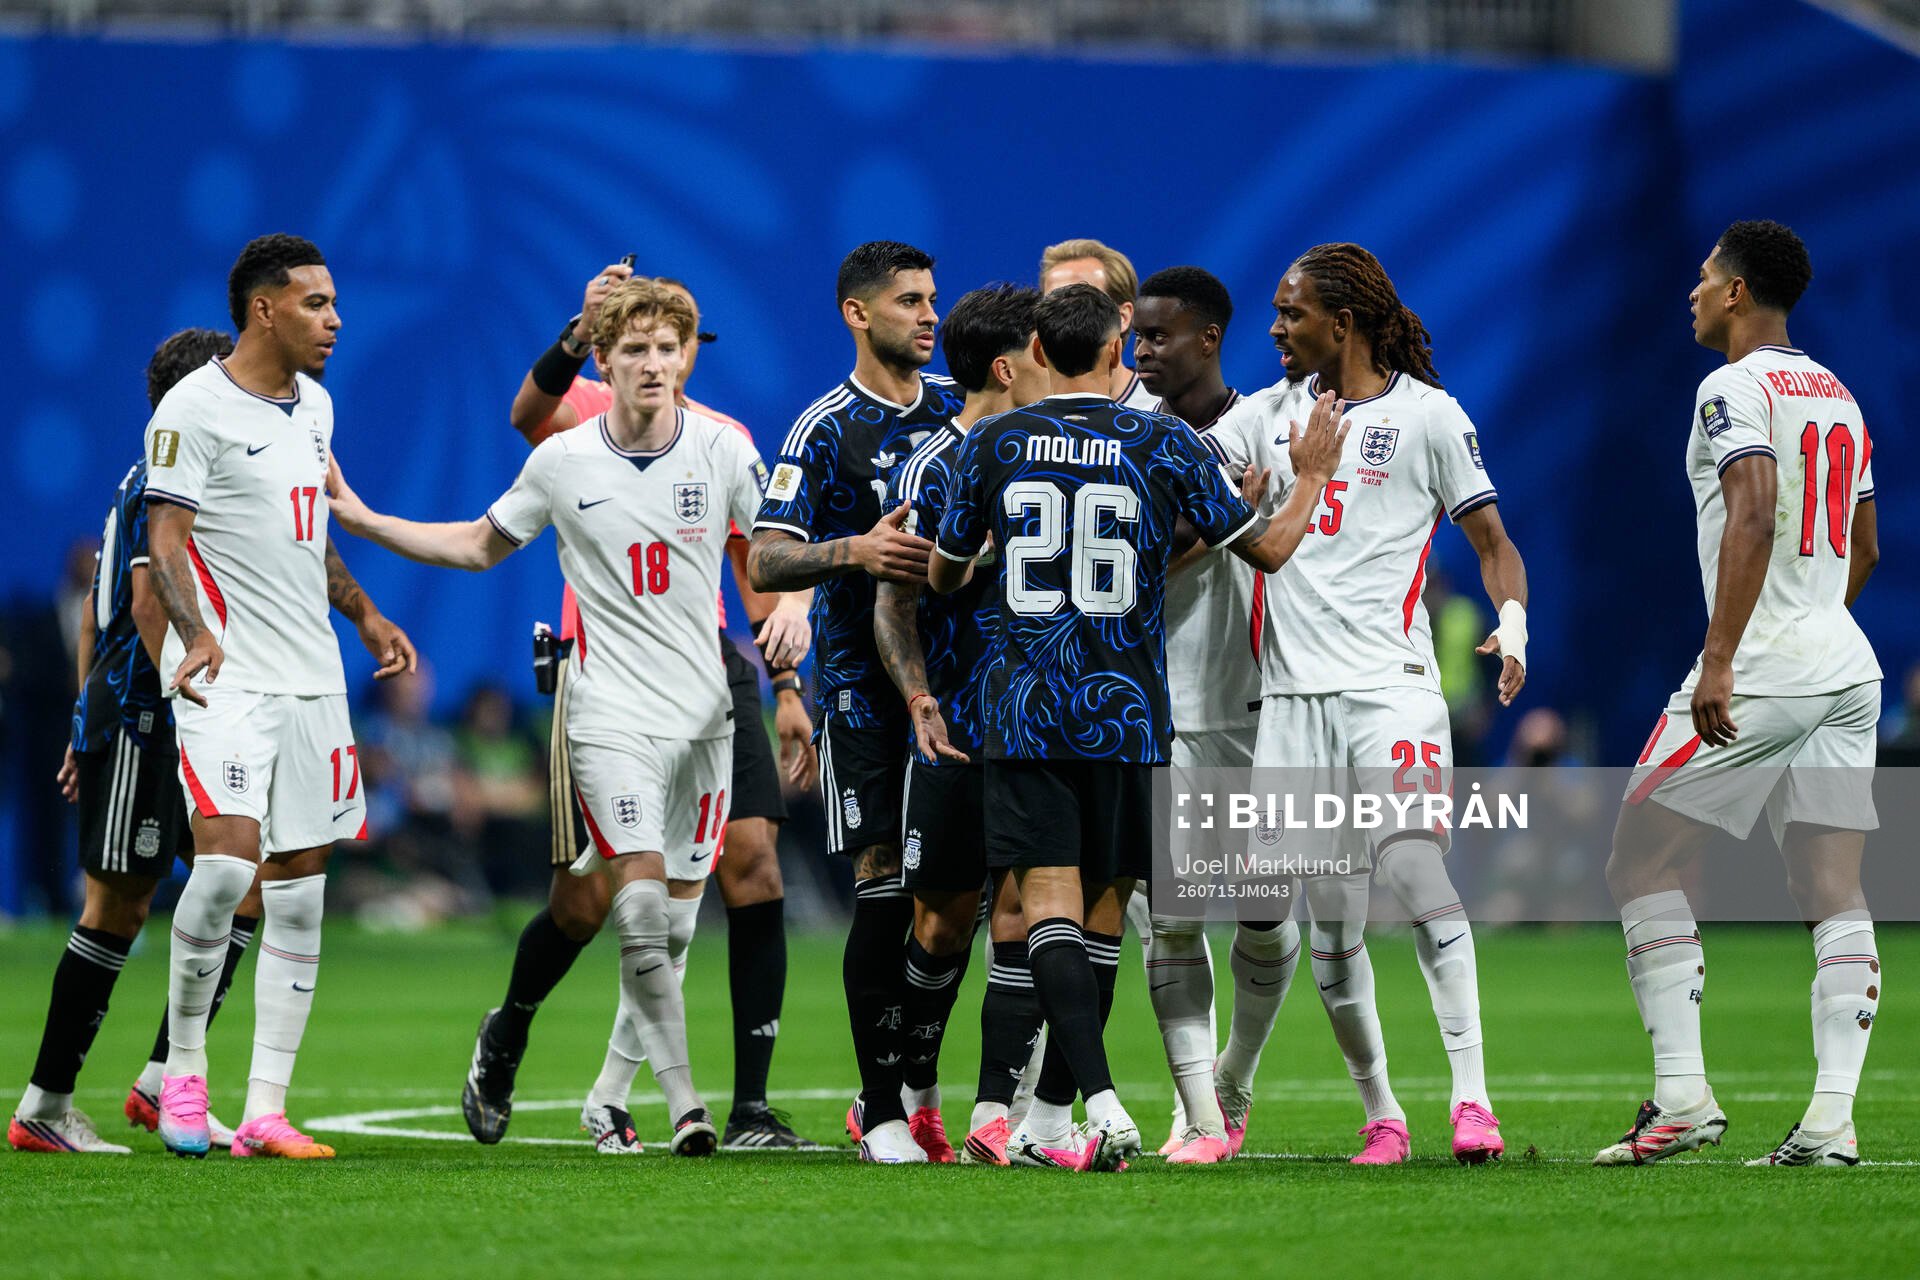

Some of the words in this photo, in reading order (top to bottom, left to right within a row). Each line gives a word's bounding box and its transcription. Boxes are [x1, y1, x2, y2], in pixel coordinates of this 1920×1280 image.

[1026, 435, 1121, 466] MOLINA
[1356, 467, 1389, 480] ARGENTINA
[290, 486, 318, 541] 17
[1304, 480, 1348, 536] 5
[1799, 421, 1855, 558] 10
[627, 541, 670, 596] 18
[1003, 481, 1141, 617] 26
[330, 744, 359, 802] 17
[1391, 740, 1442, 794] 25
[695, 789, 725, 843] 18
